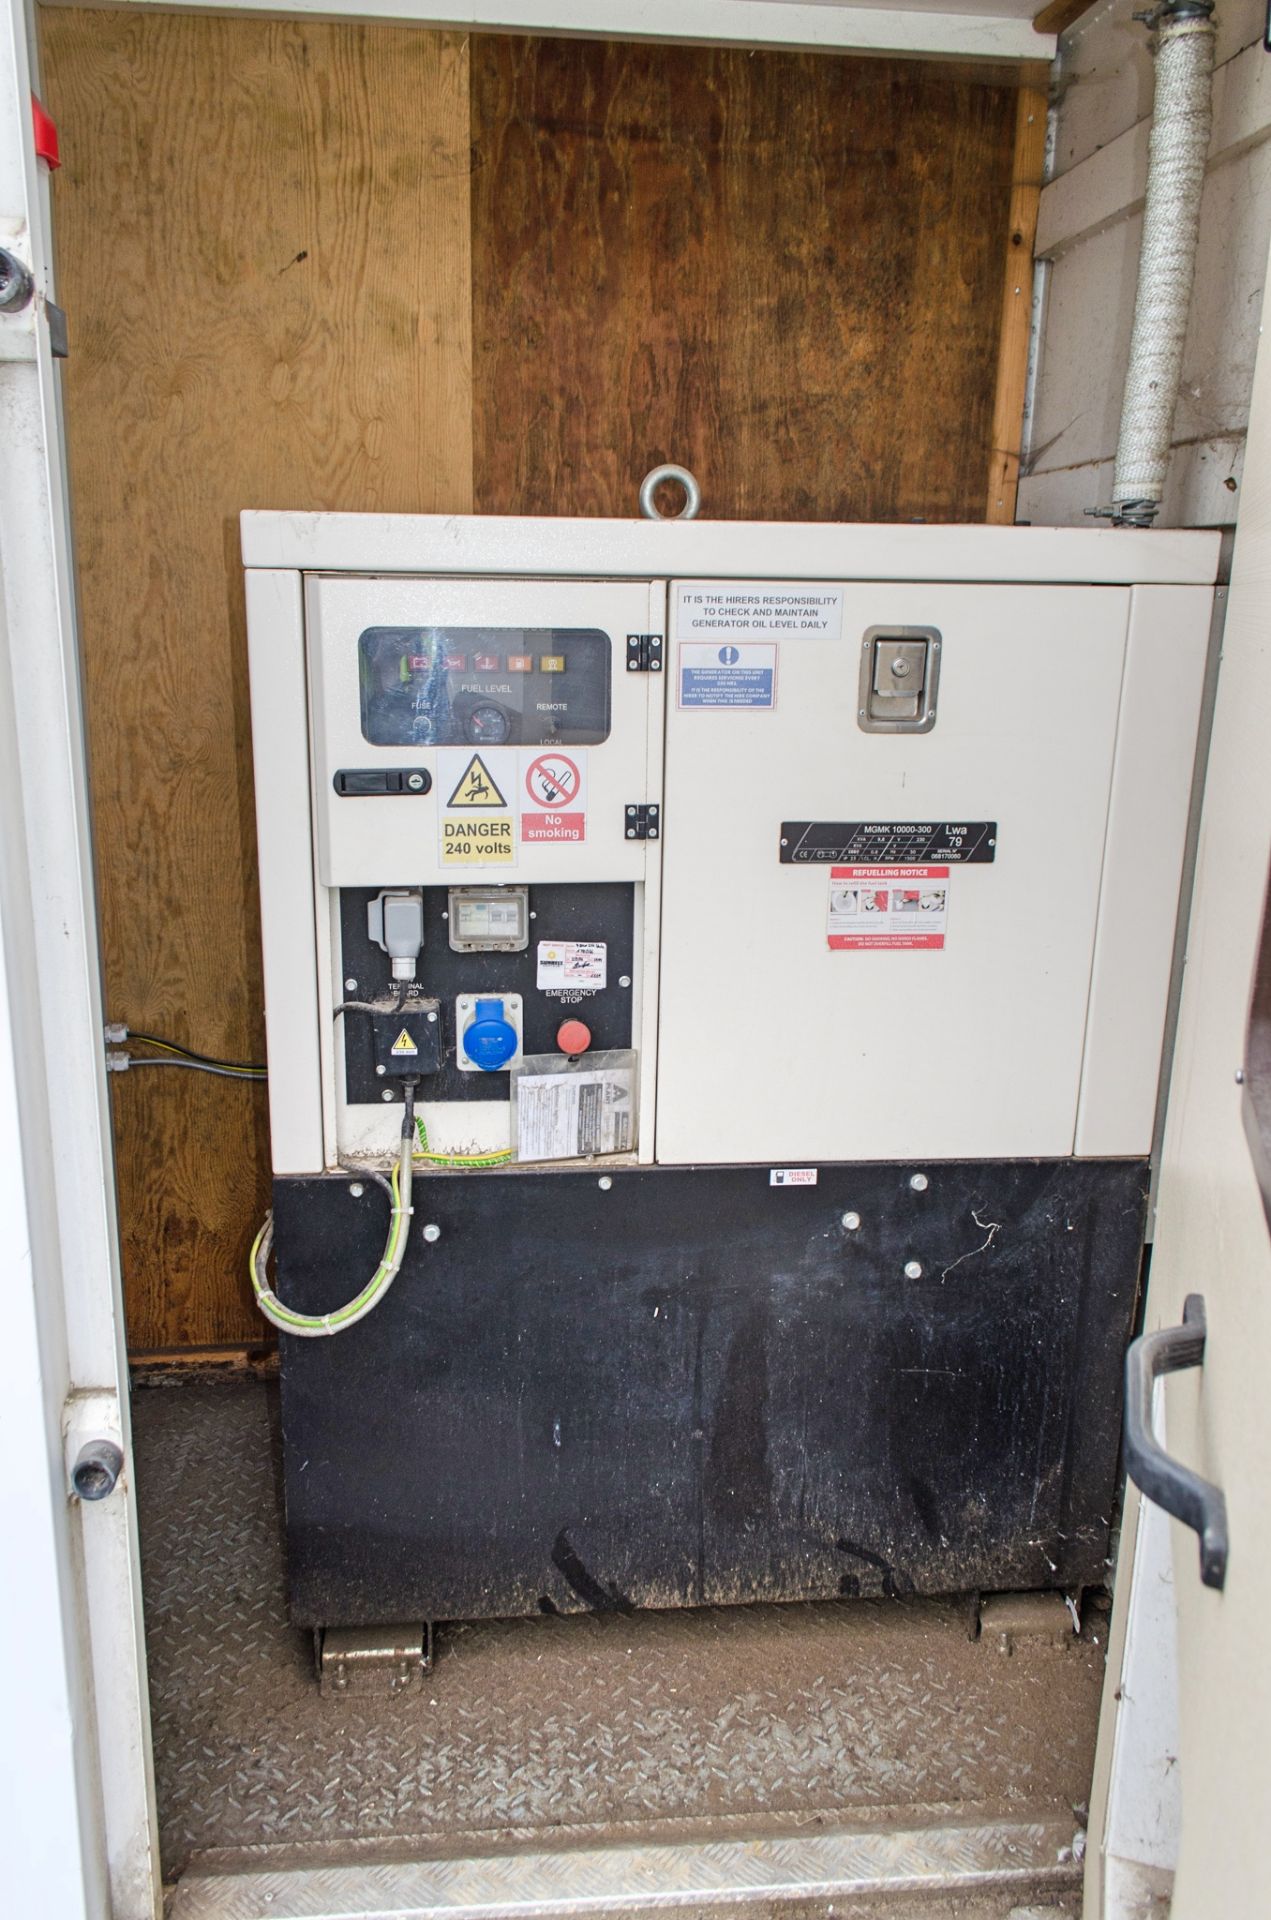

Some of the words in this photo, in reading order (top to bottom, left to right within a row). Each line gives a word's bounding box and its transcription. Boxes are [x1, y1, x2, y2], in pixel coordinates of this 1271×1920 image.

[683, 596, 693, 604] IT
[694, 596, 703, 604] IS
[705, 596, 723, 604] THE
[726, 596, 760, 605] HIRERS
[763, 597, 838, 605] RESPONSIBILITY
[703, 608, 715, 616] TO
[718, 608, 750, 616] CHECK
[752, 608, 772, 616] AND
[775, 609, 818, 617] MAINTAIN
[692, 620, 750, 628] GENERATOR
[752, 620, 767, 628] OIL
[770, 620, 798, 629] LEVEL
[801, 621, 828, 629] DAILY
[462, 684, 483, 692] FUEL
[486, 684, 512, 693] LEVEL
[545, 815, 562, 825] No
[444, 824, 511, 837] DANGER
[528, 828, 579, 840] smoking
[946, 825, 967, 835] Lwa
[948, 837, 962, 847] 79
[446, 843, 470, 854] 240
[476, 842, 511, 854] volts
